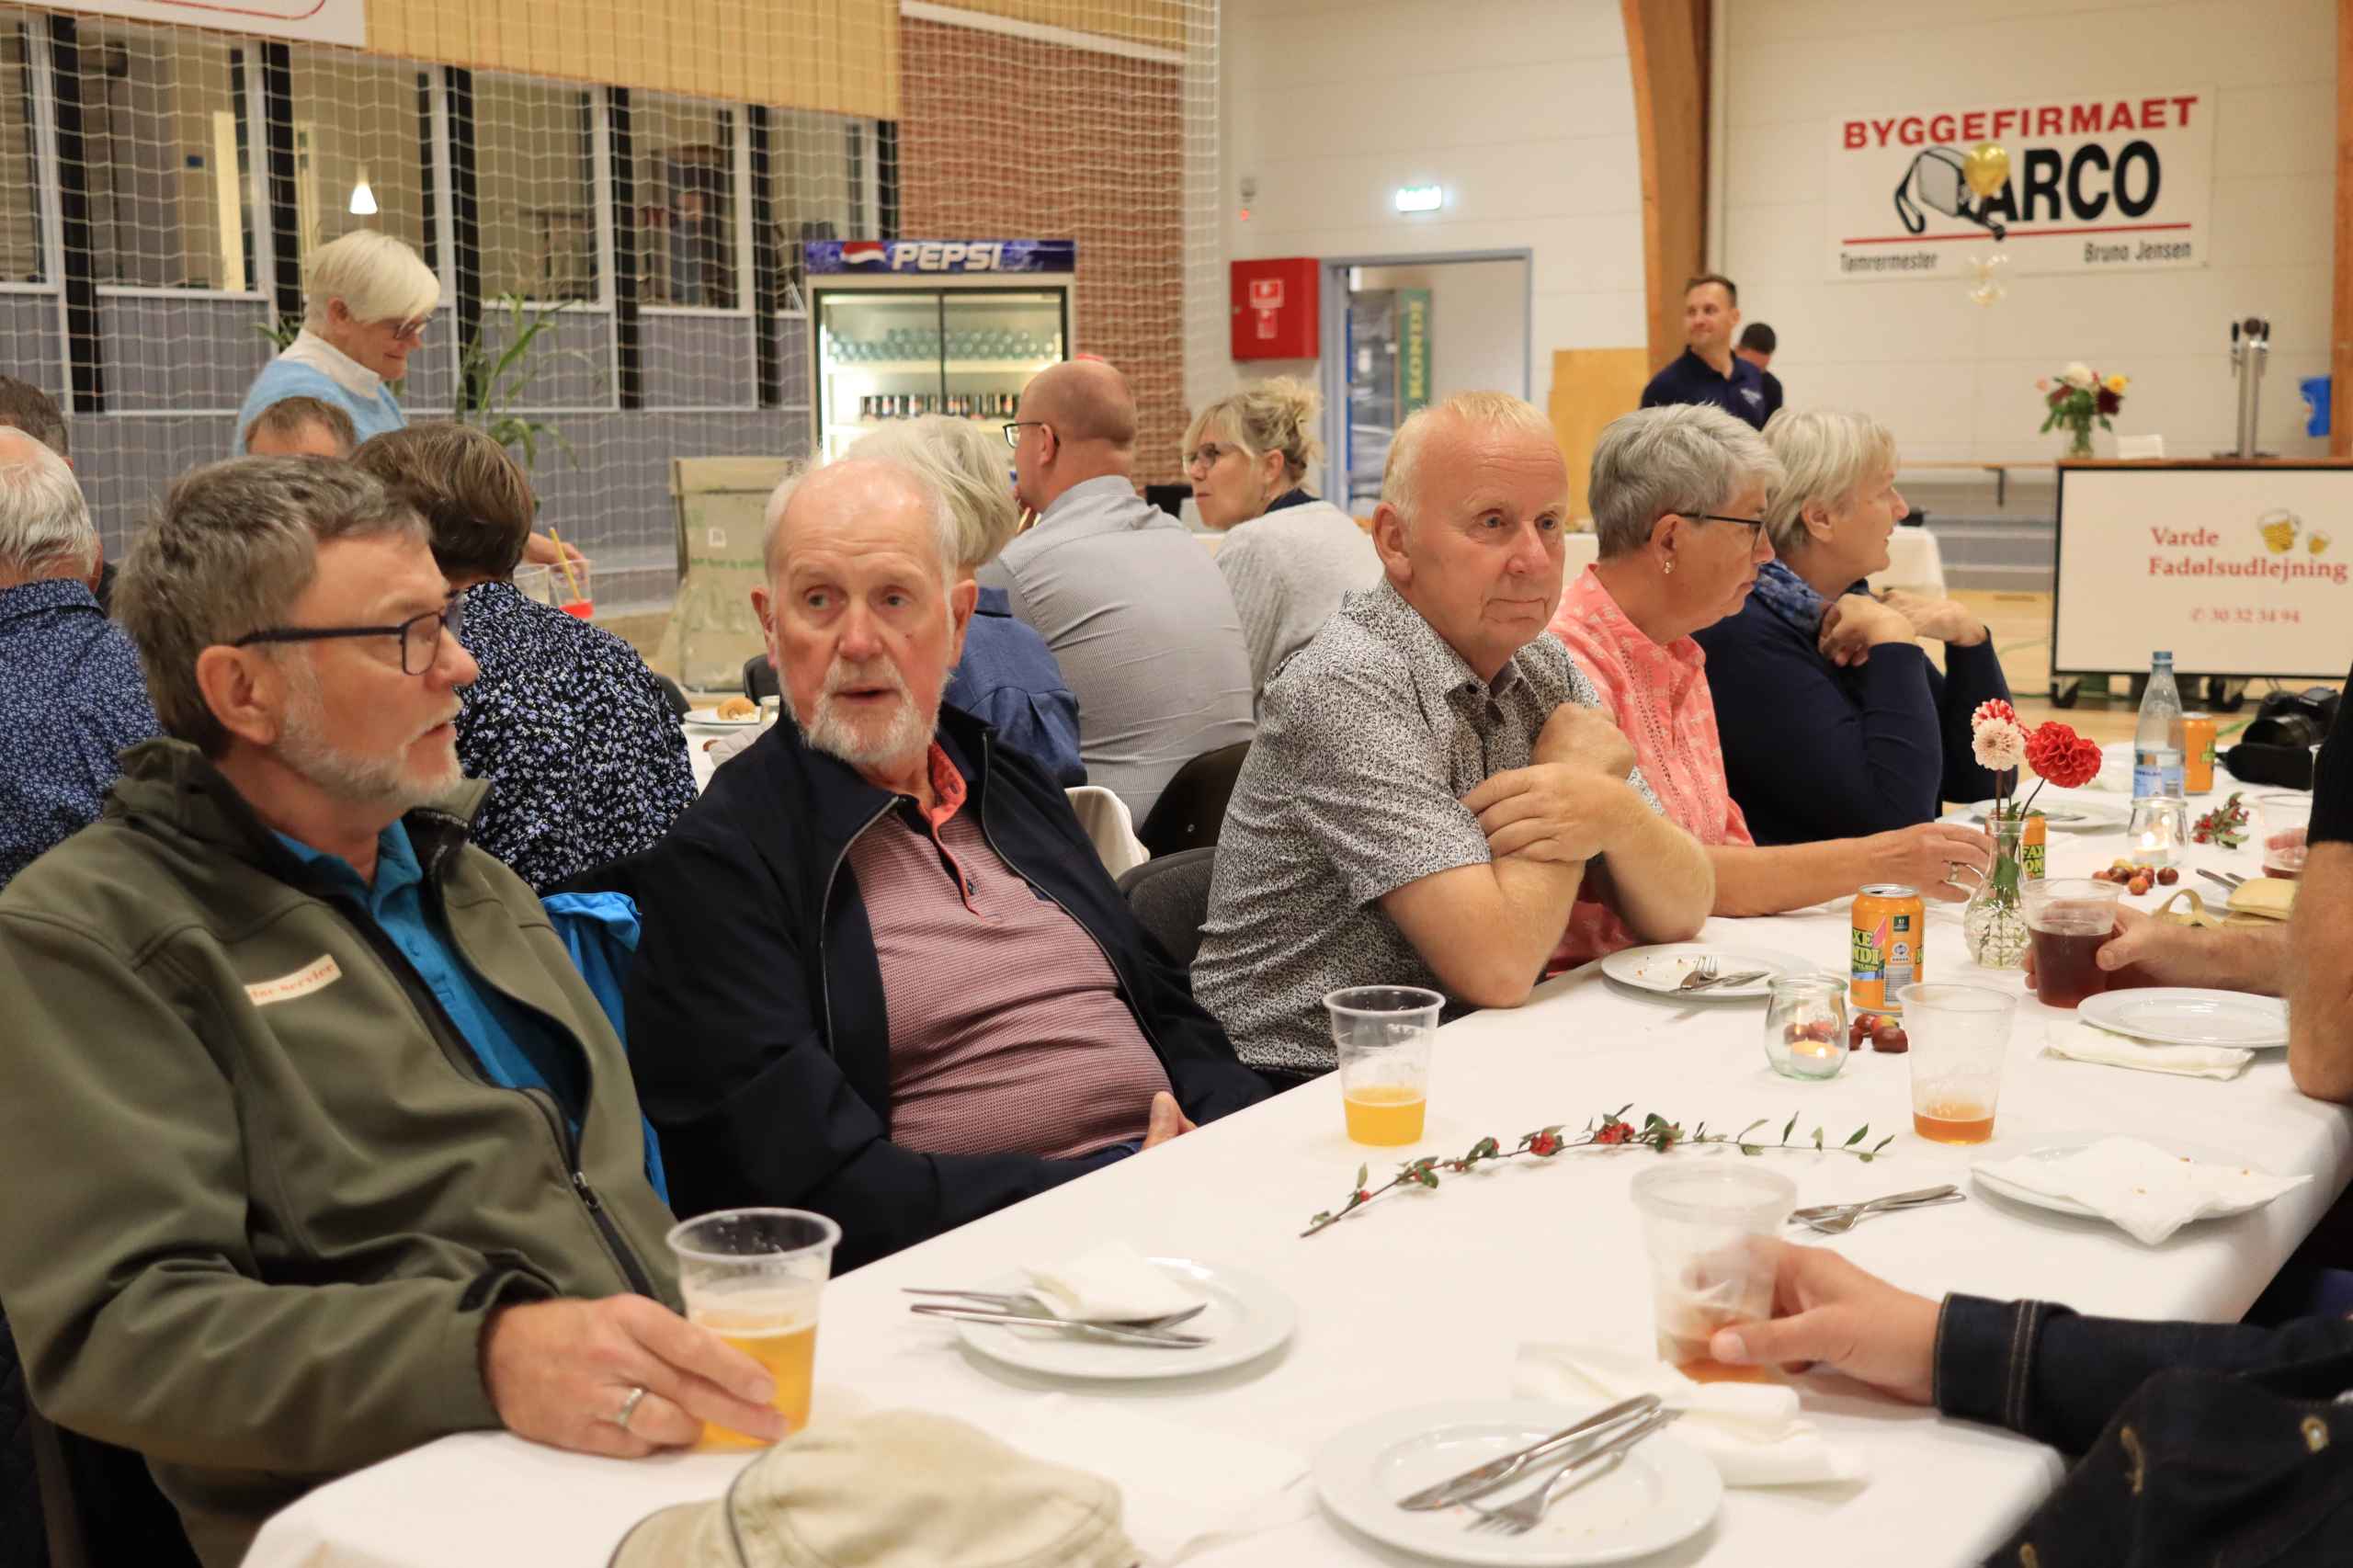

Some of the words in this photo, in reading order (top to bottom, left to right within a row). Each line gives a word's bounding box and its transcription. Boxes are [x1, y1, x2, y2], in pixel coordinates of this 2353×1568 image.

[1843, 96, 2198, 150] BYGGEFIRMAET
[891, 242, 1004, 270] PEPSI
[2084, 242, 2129, 263] Bruno
[2134, 240, 2192, 262] Jensen
[2151, 528, 2220, 548] Varde
[2148, 557, 2347, 585] Fadølsudlejning
